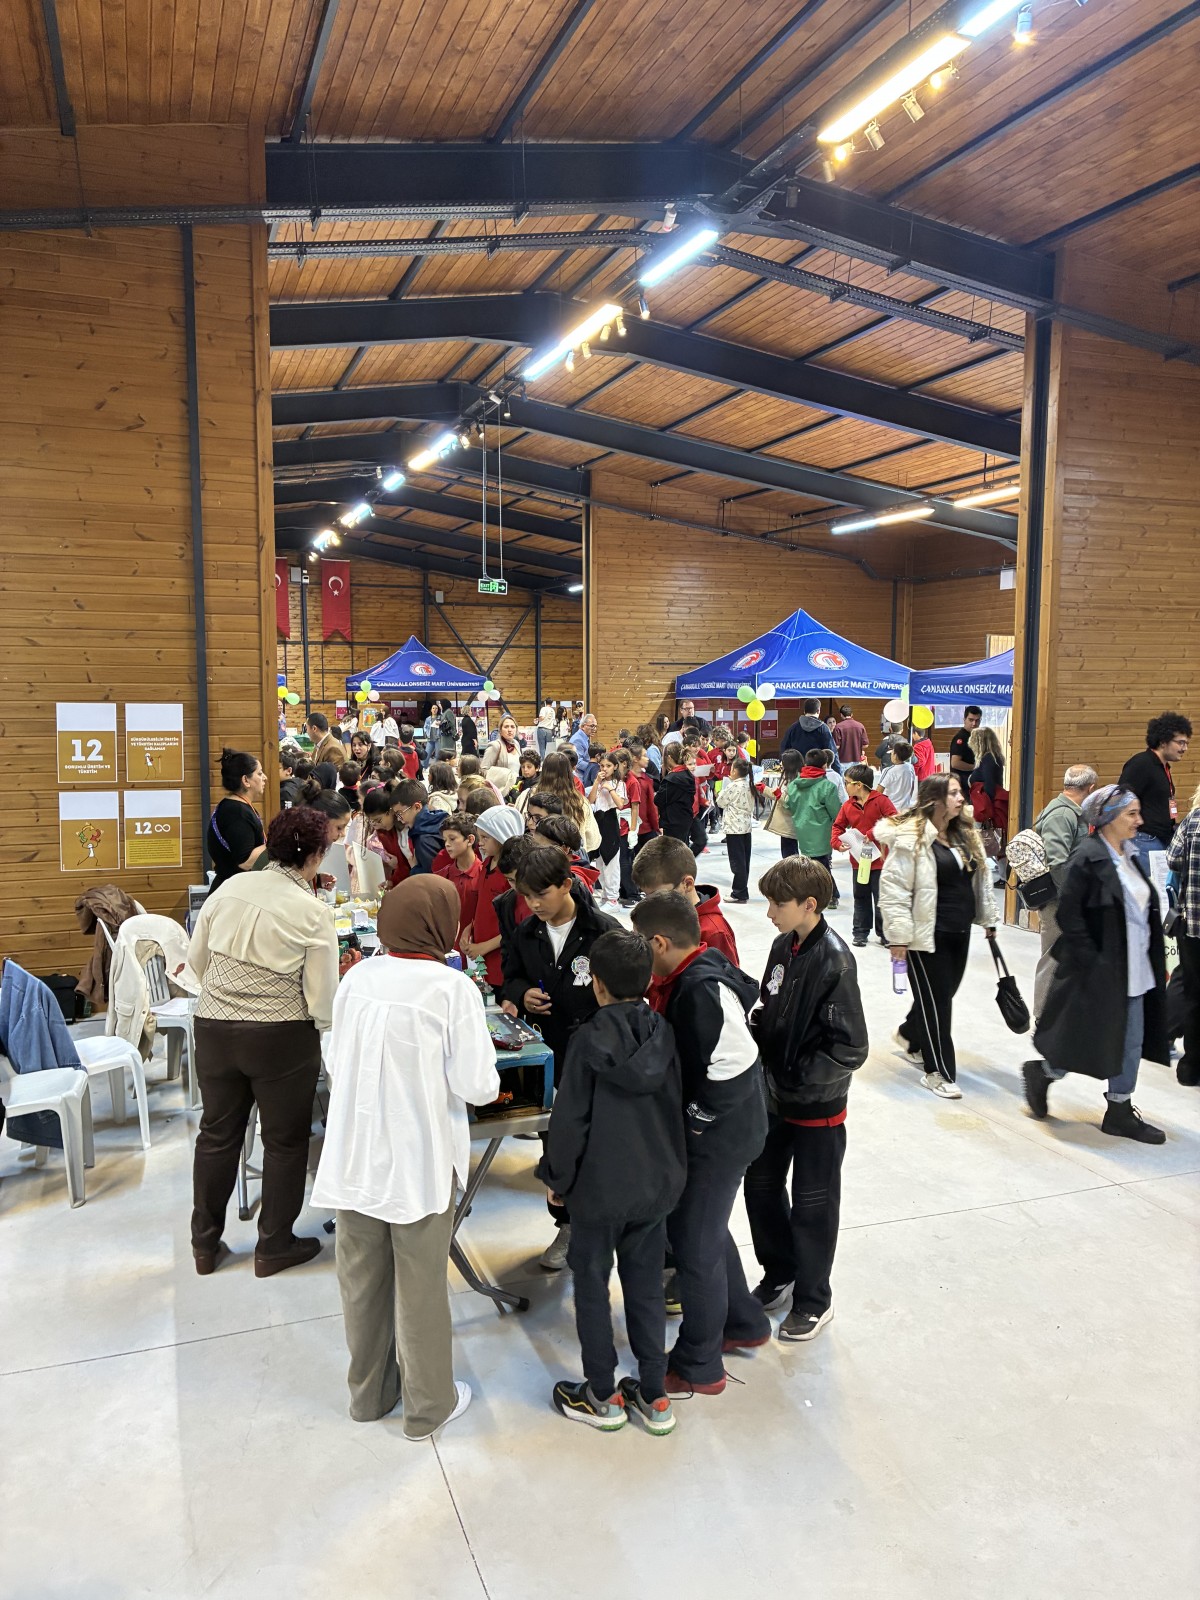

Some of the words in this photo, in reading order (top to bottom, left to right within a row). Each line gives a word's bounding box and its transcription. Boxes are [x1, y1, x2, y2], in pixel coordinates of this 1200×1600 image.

[817, 679, 849, 689] ONSEKİZ
[850, 681, 871, 689] MART
[920, 684, 963, 695] ÇANAKKALE
[964, 682, 996, 694] ONSEKİZ
[71, 739, 104, 762] 12
[135, 821, 153, 835] 12
